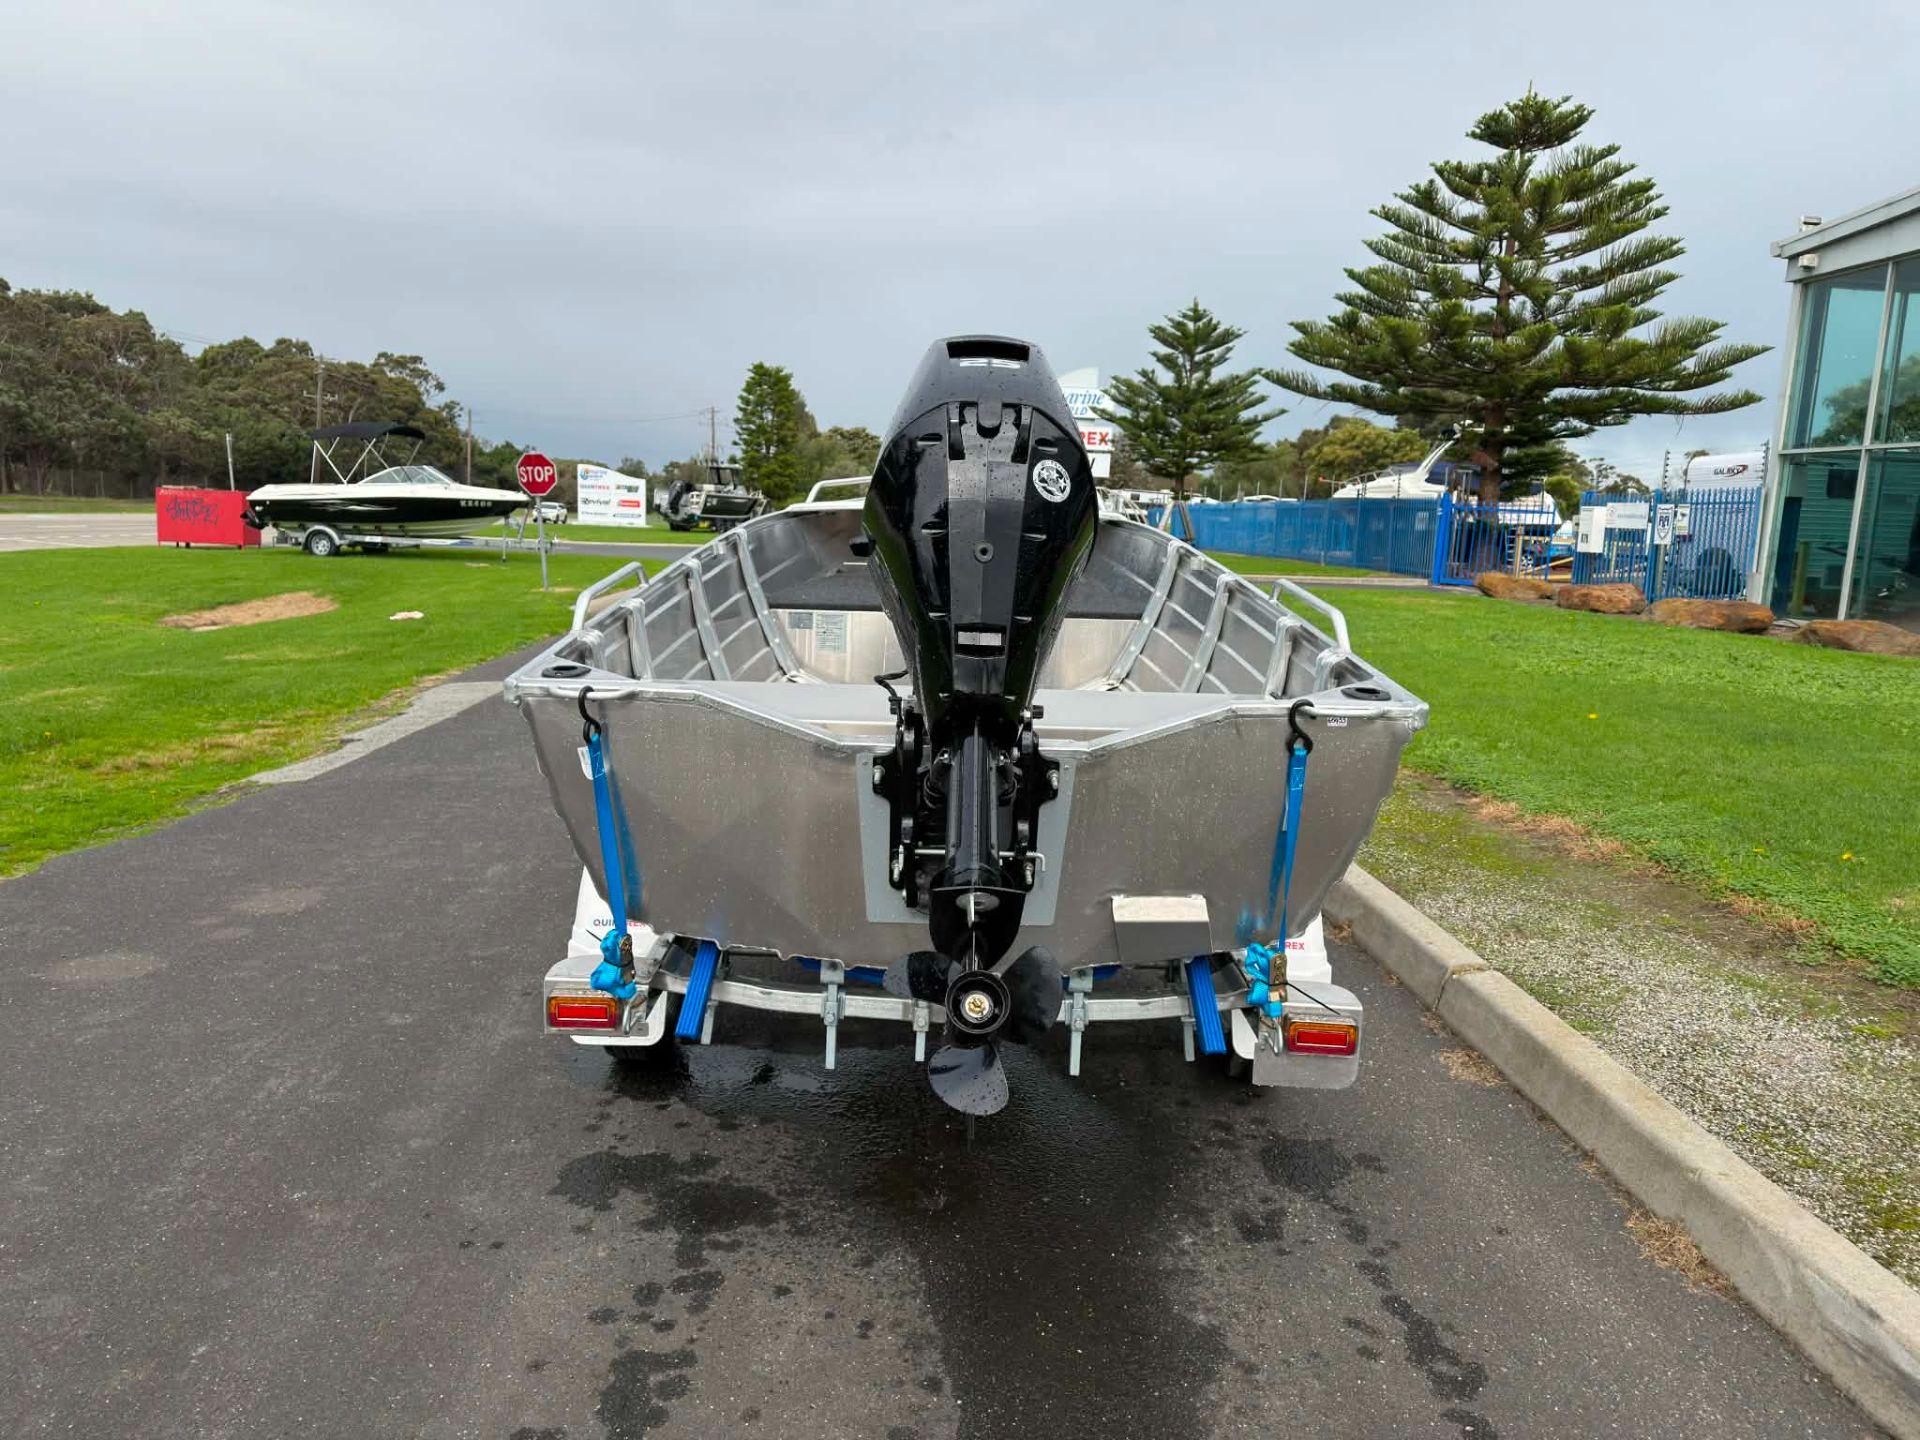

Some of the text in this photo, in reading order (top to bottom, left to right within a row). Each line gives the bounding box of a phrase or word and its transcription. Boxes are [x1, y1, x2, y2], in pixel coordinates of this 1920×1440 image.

[1066, 390, 1105, 405] arine
[519, 466, 553, 483] STOP
[1285, 941, 1305, 950] REX
